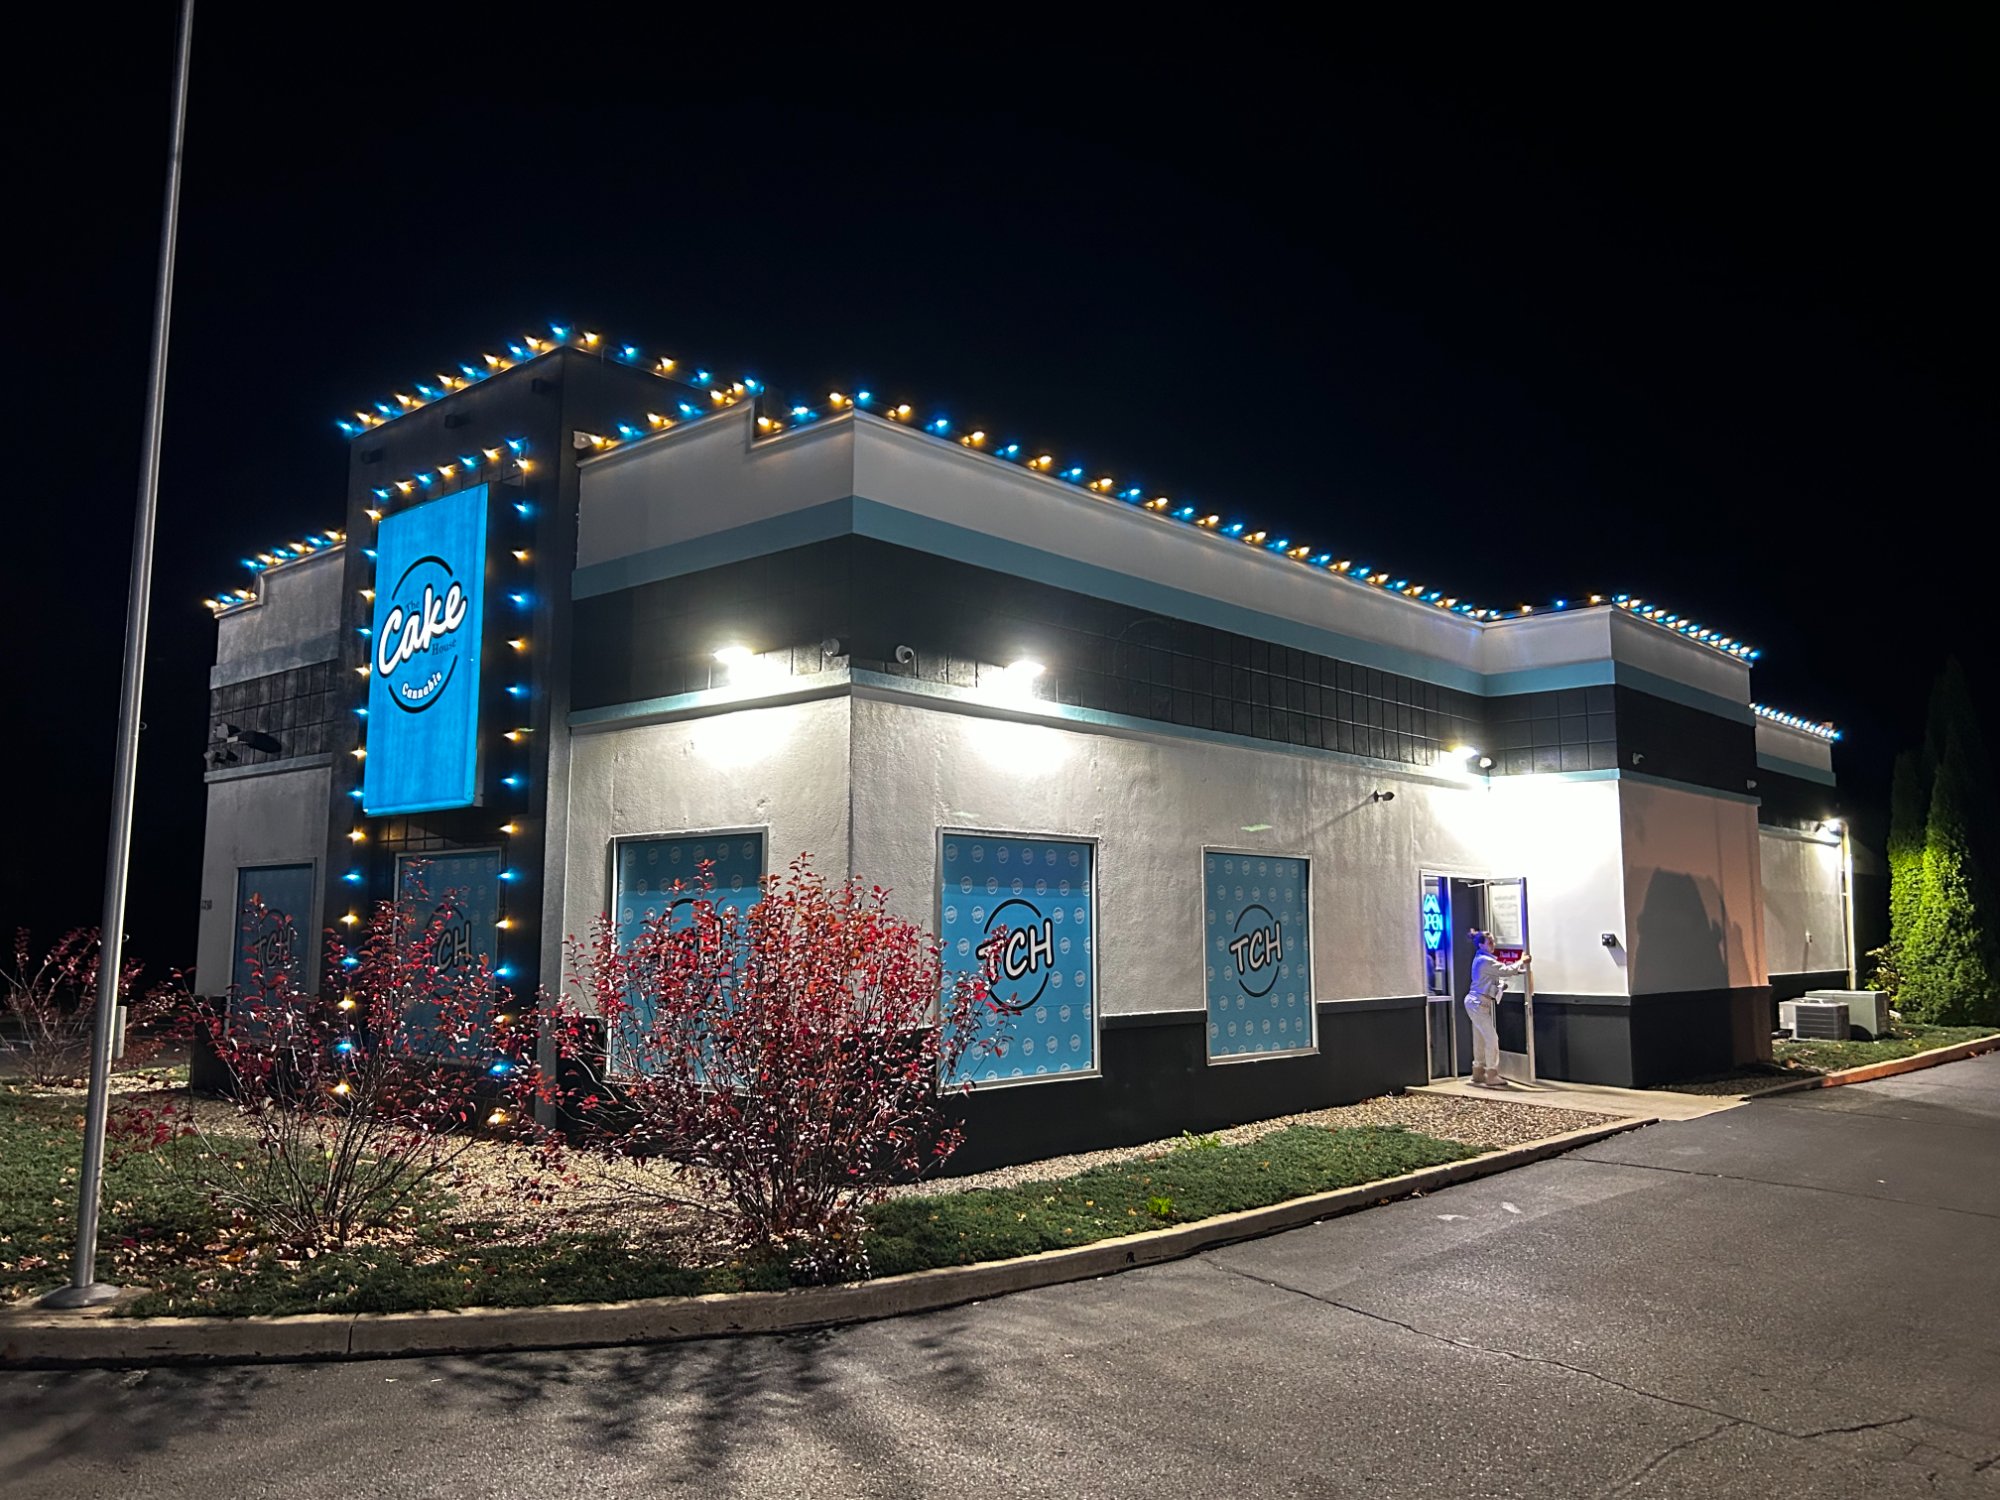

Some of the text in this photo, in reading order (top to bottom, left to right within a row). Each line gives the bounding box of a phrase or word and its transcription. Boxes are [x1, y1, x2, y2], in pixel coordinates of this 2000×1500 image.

[405, 600, 420, 613] The
[377, 581, 468, 678] Cake
[432, 639, 457, 656] House
[402, 672, 442, 699] Cannabis
[976, 919, 1054, 984] TCH
[1229, 920, 1282, 975] TCH
